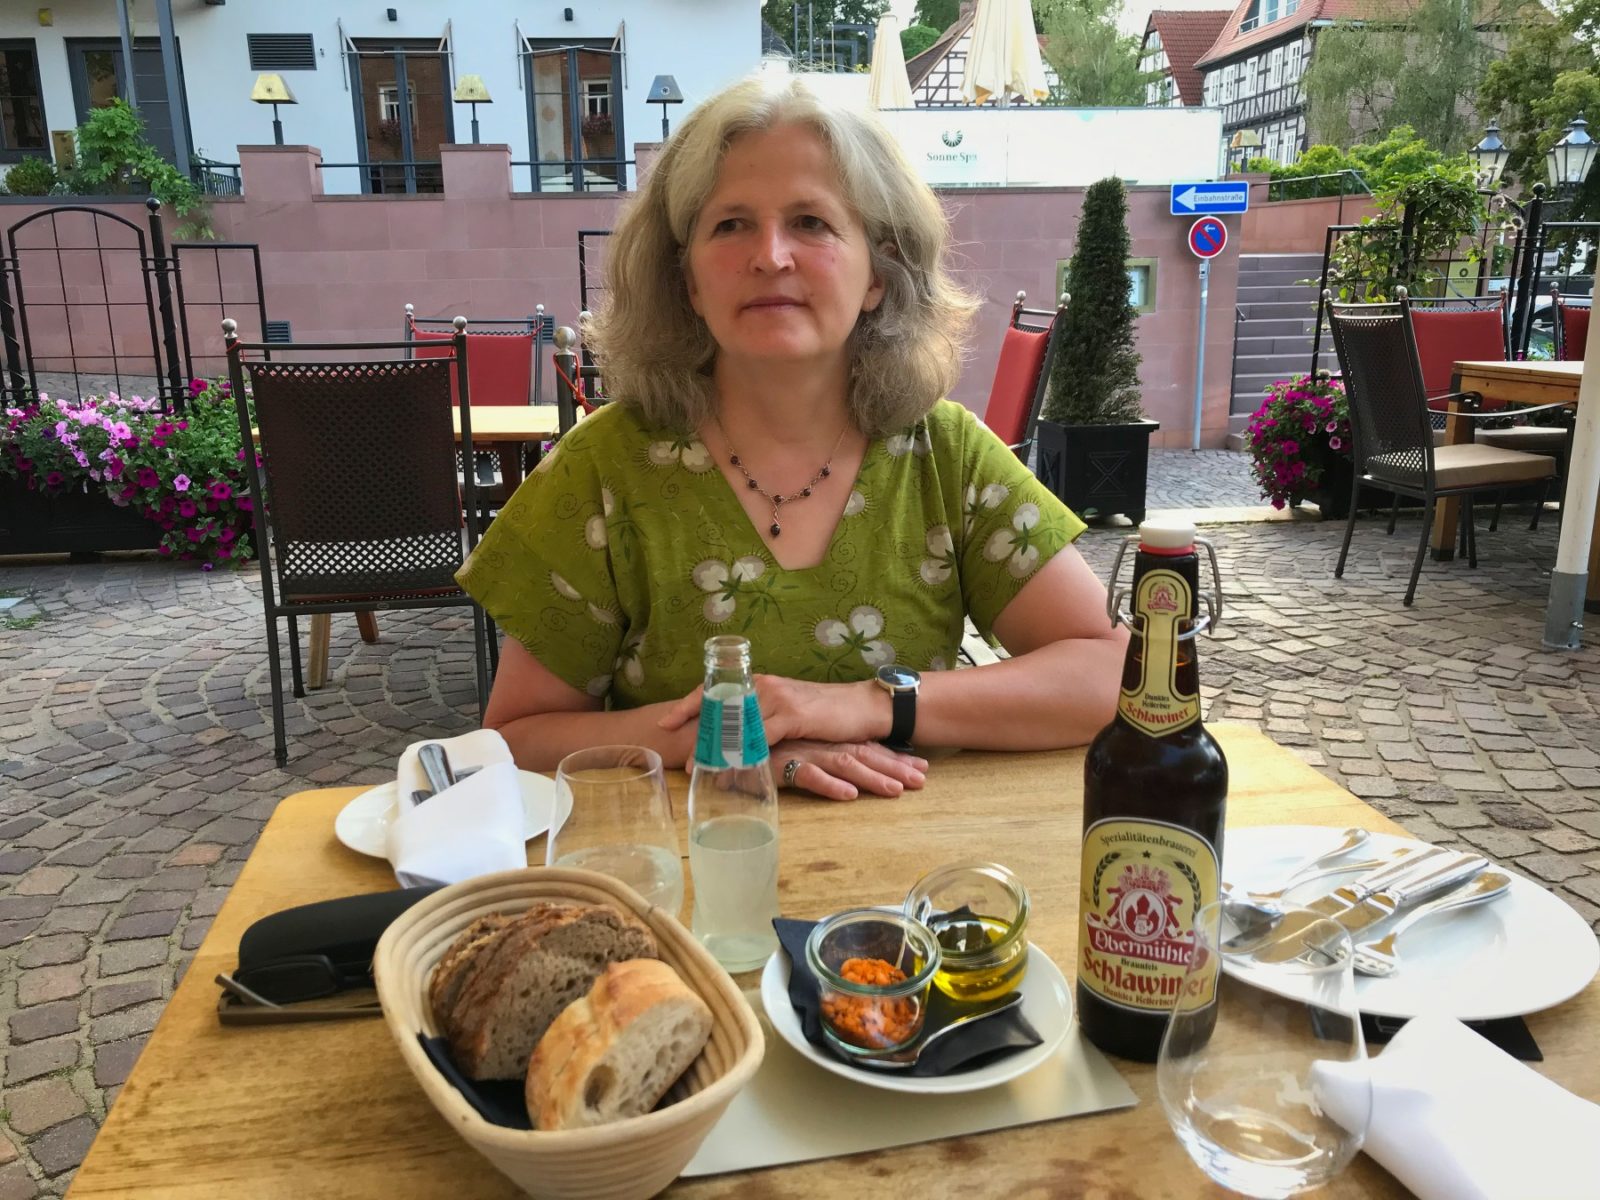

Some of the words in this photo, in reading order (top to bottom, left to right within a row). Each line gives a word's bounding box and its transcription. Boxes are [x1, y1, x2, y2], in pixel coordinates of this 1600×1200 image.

[926, 152, 958, 161] Sonne
[1193, 192, 1244, 202] Einbahnstraße
[1125, 701, 1189, 724] Schlawiner
[1100, 832, 1199, 859] Spezialitätenbrauerei
[1121, 957, 1158, 971] Braunfels
